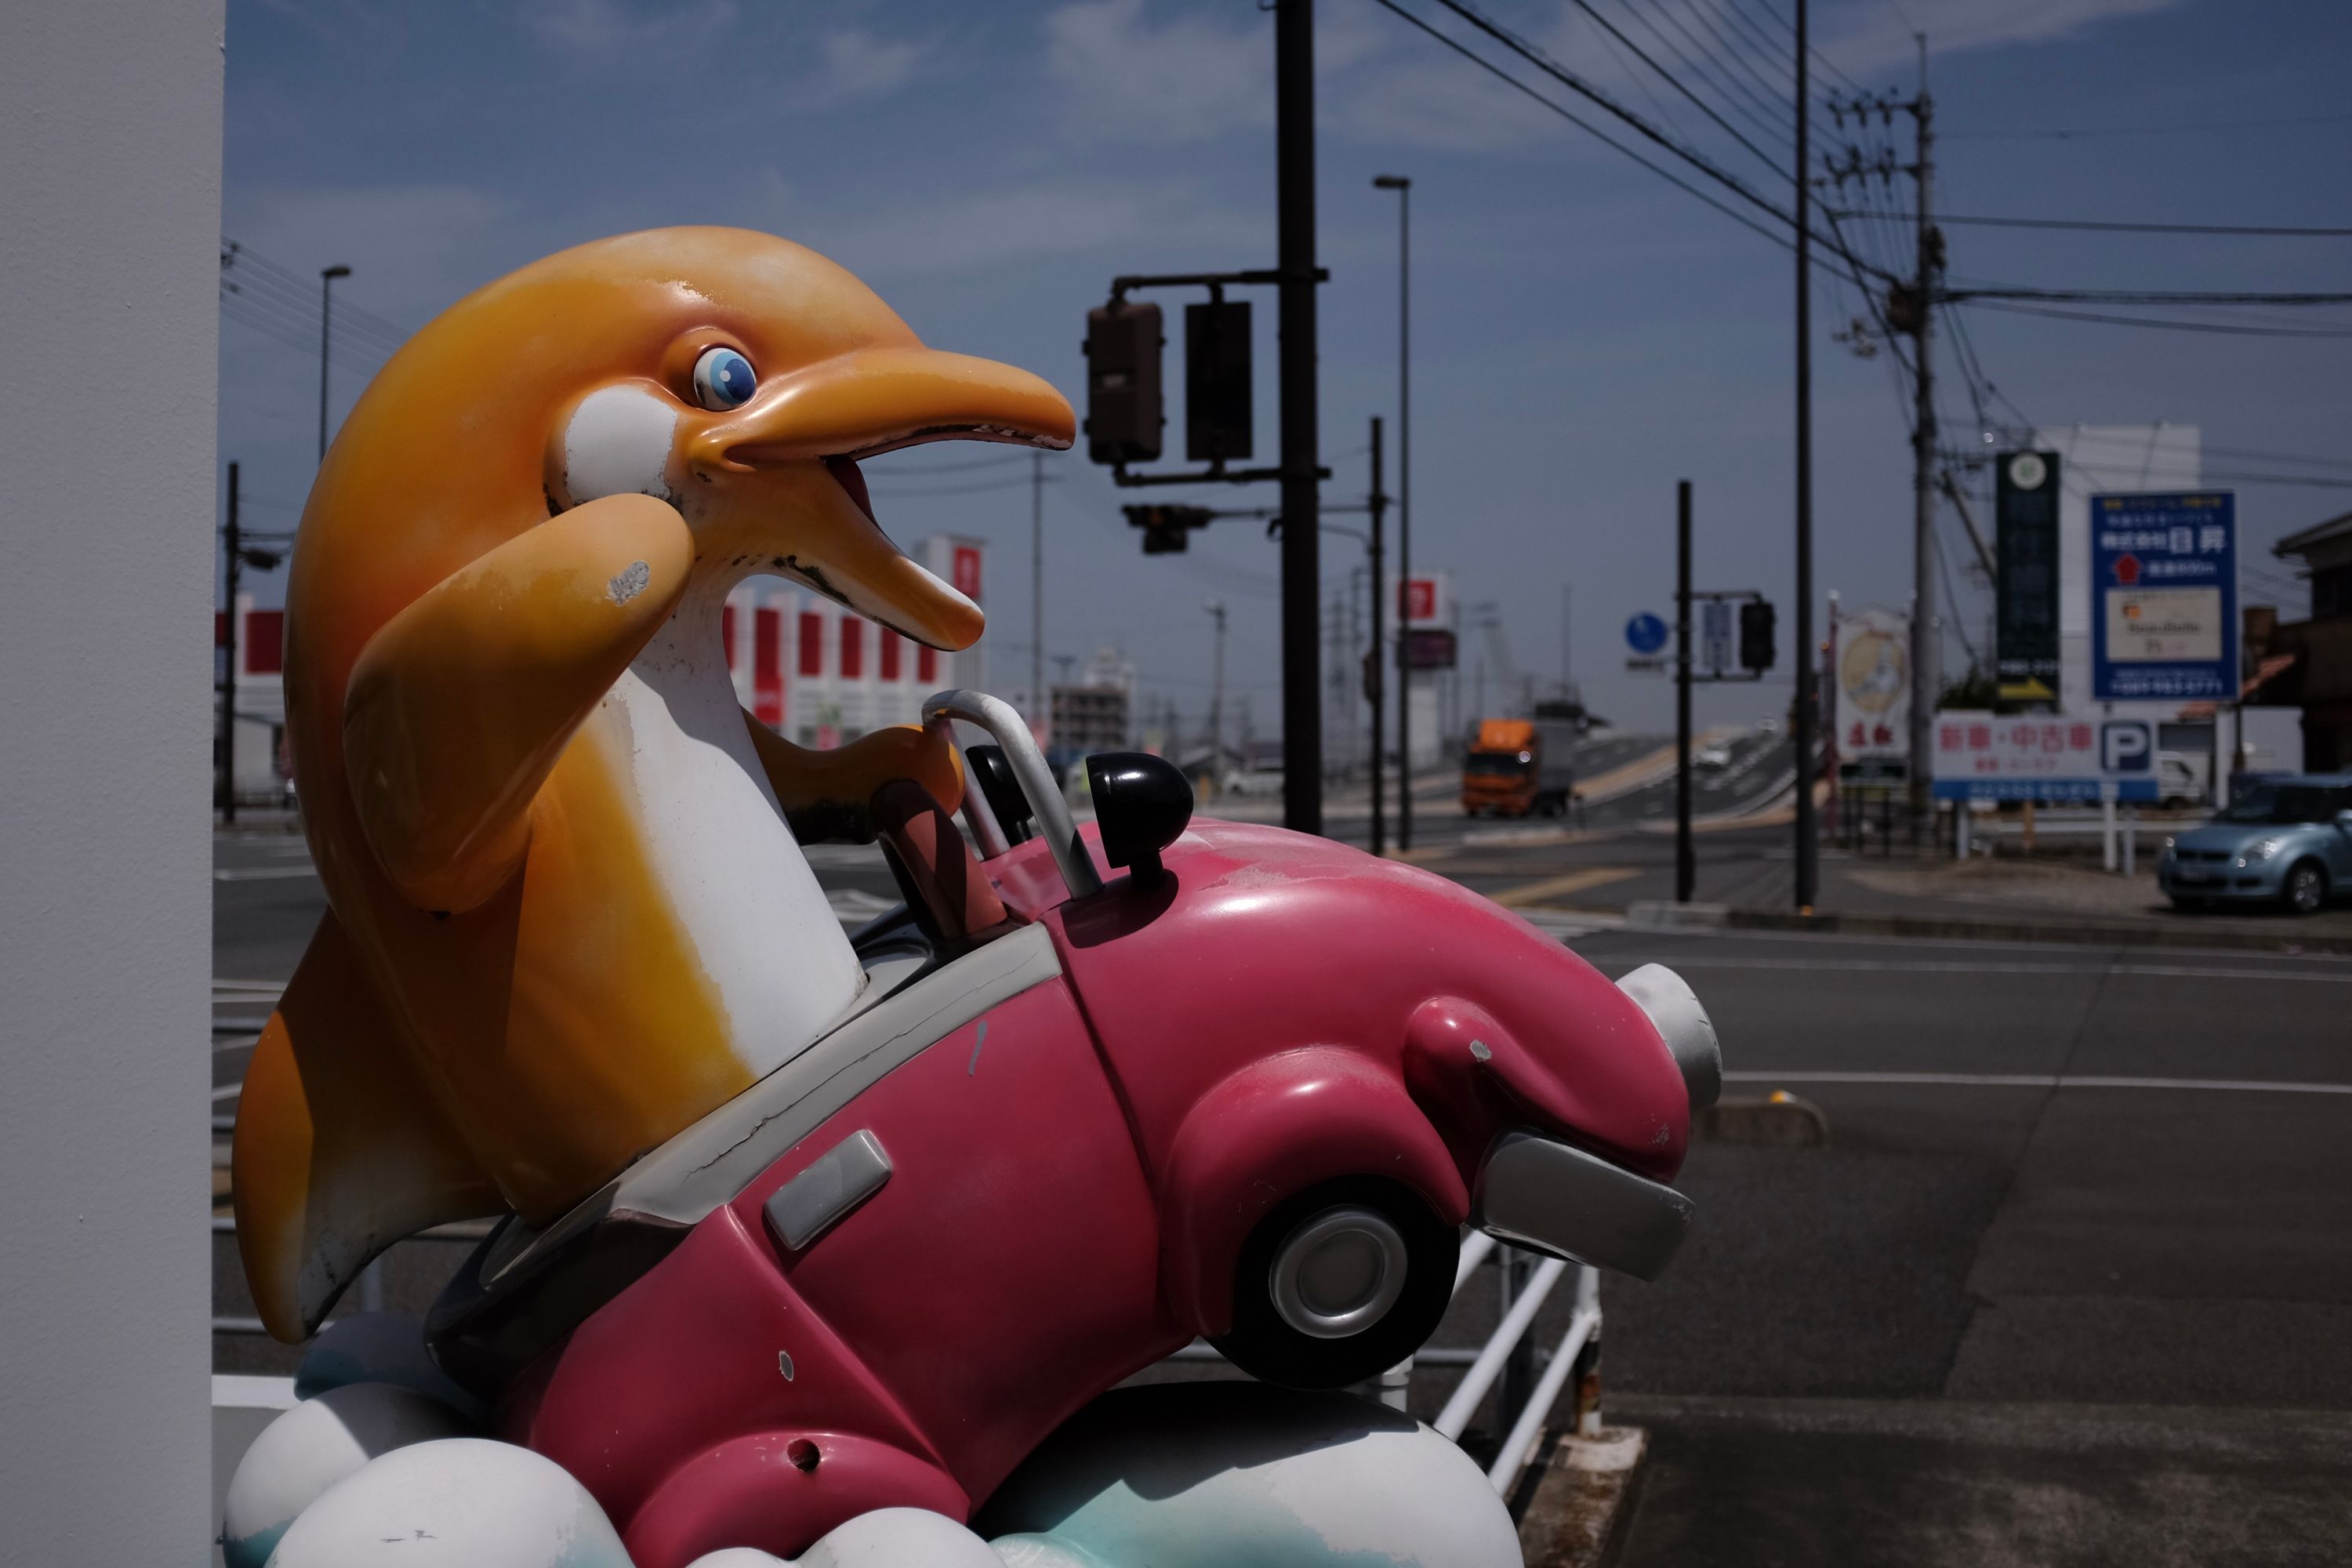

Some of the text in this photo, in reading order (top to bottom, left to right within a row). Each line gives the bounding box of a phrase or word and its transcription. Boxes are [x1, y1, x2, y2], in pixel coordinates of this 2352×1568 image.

[1940, 722, 2092, 753] 新車・中古車
[2107, 727, 2147, 771] P
